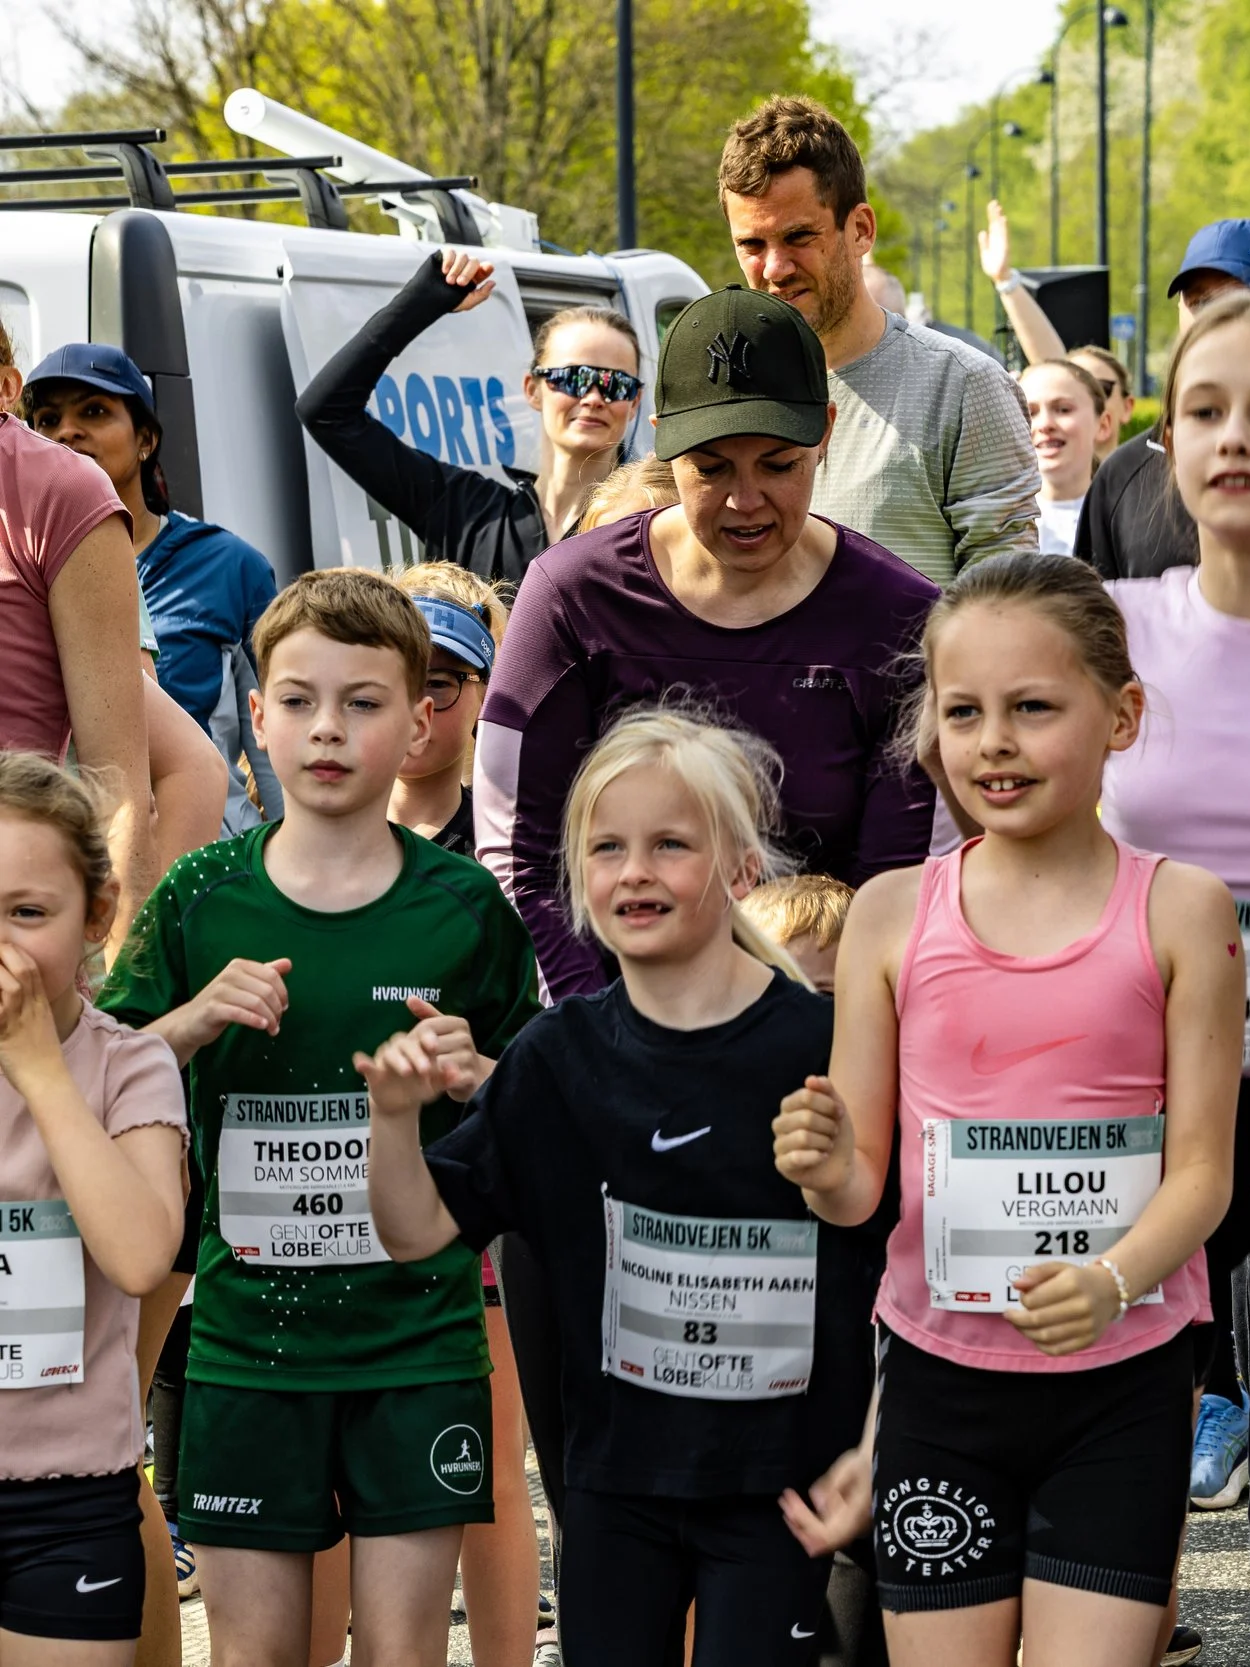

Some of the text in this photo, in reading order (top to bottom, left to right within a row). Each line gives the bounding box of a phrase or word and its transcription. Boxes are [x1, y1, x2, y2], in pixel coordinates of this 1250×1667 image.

[366, 372, 515, 467] PORTS
[372, 986, 441, 1002] HVRUNNERS
[236, 1097, 370, 1123] STRANDVEJEN 5
[967, 1125, 1101, 1150] STRANDVEJEN
[1106, 1123, 1127, 1149] 5K
[253, 1138, 370, 1162] THEODO
[254, 1166, 293, 1182] DAM
[1017, 1171, 1106, 1195] LILOU
[293, 1193, 343, 1216] 460
[1002, 1198, 1119, 1217] VERGMANN
[9, 1207, 35, 1232] 5K
[270, 1222, 370, 1241] GENTOFTE
[632, 1211, 741, 1249] STRANDVEJEN
[747, 1225, 772, 1250] 5K
[271, 1239, 371, 1257] LØBEKLUB
[1034, 1230, 1090, 1255] 218
[621, 1258, 815, 1293] NICOLINE ELISABETH AAEN
[669, 1290, 737, 1312] NISSEN
[684, 1321, 718, 1345] 83
[653, 1346, 754, 1373] GENTOFTE
[653, 1366, 754, 1391] LØBEKLUB
[440, 1461, 482, 1474] HVRUNNERS
[193, 1493, 263, 1515] TRIMTEX
[881, 1477, 996, 1576] DET KONGELIGE TEATER
